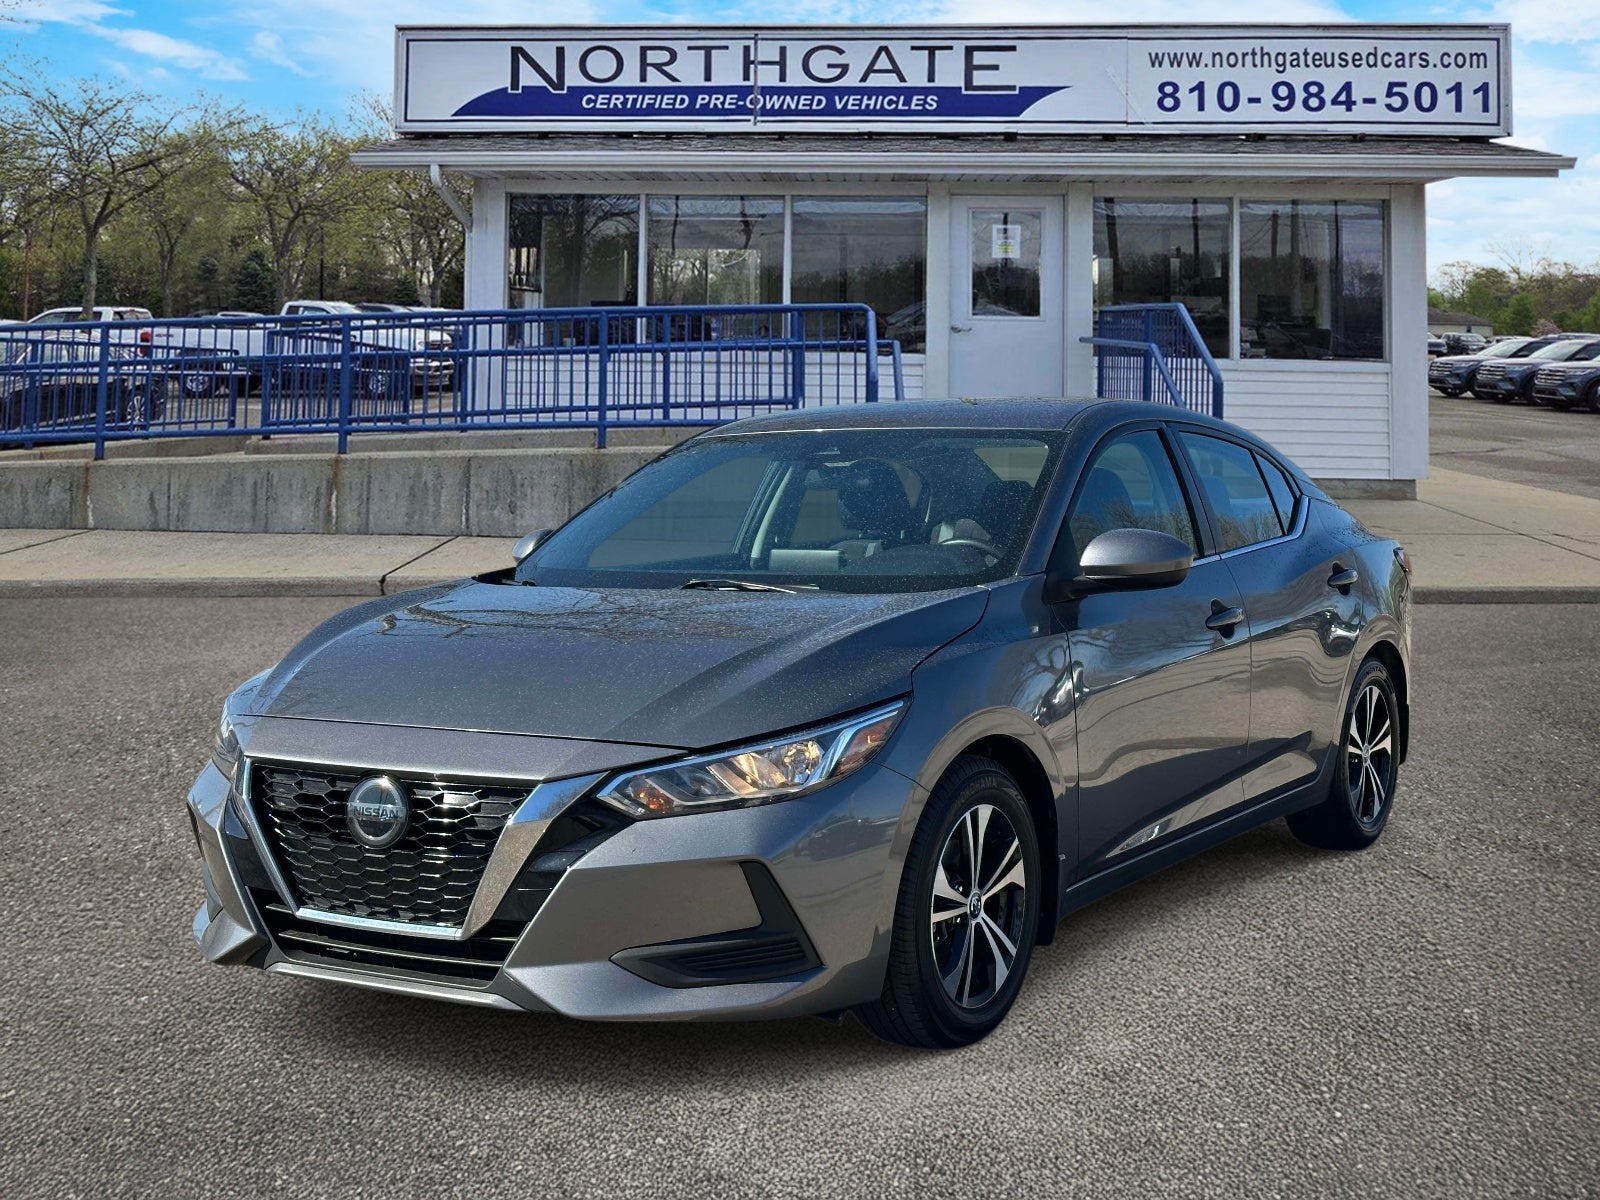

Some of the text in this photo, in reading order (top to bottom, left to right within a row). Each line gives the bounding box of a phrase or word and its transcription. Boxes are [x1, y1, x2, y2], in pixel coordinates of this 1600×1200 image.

[510, 45, 1018, 92] NORTHGATE
[1148, 46, 1488, 74] www.northgateusedcars.com
[581, 94, 939, 111] CERTIFIED PRE-OWNED VEHICLES
[1156, 80, 1490, 113] 810-984-5011
[353, 805, 399, 819] NISSAN
